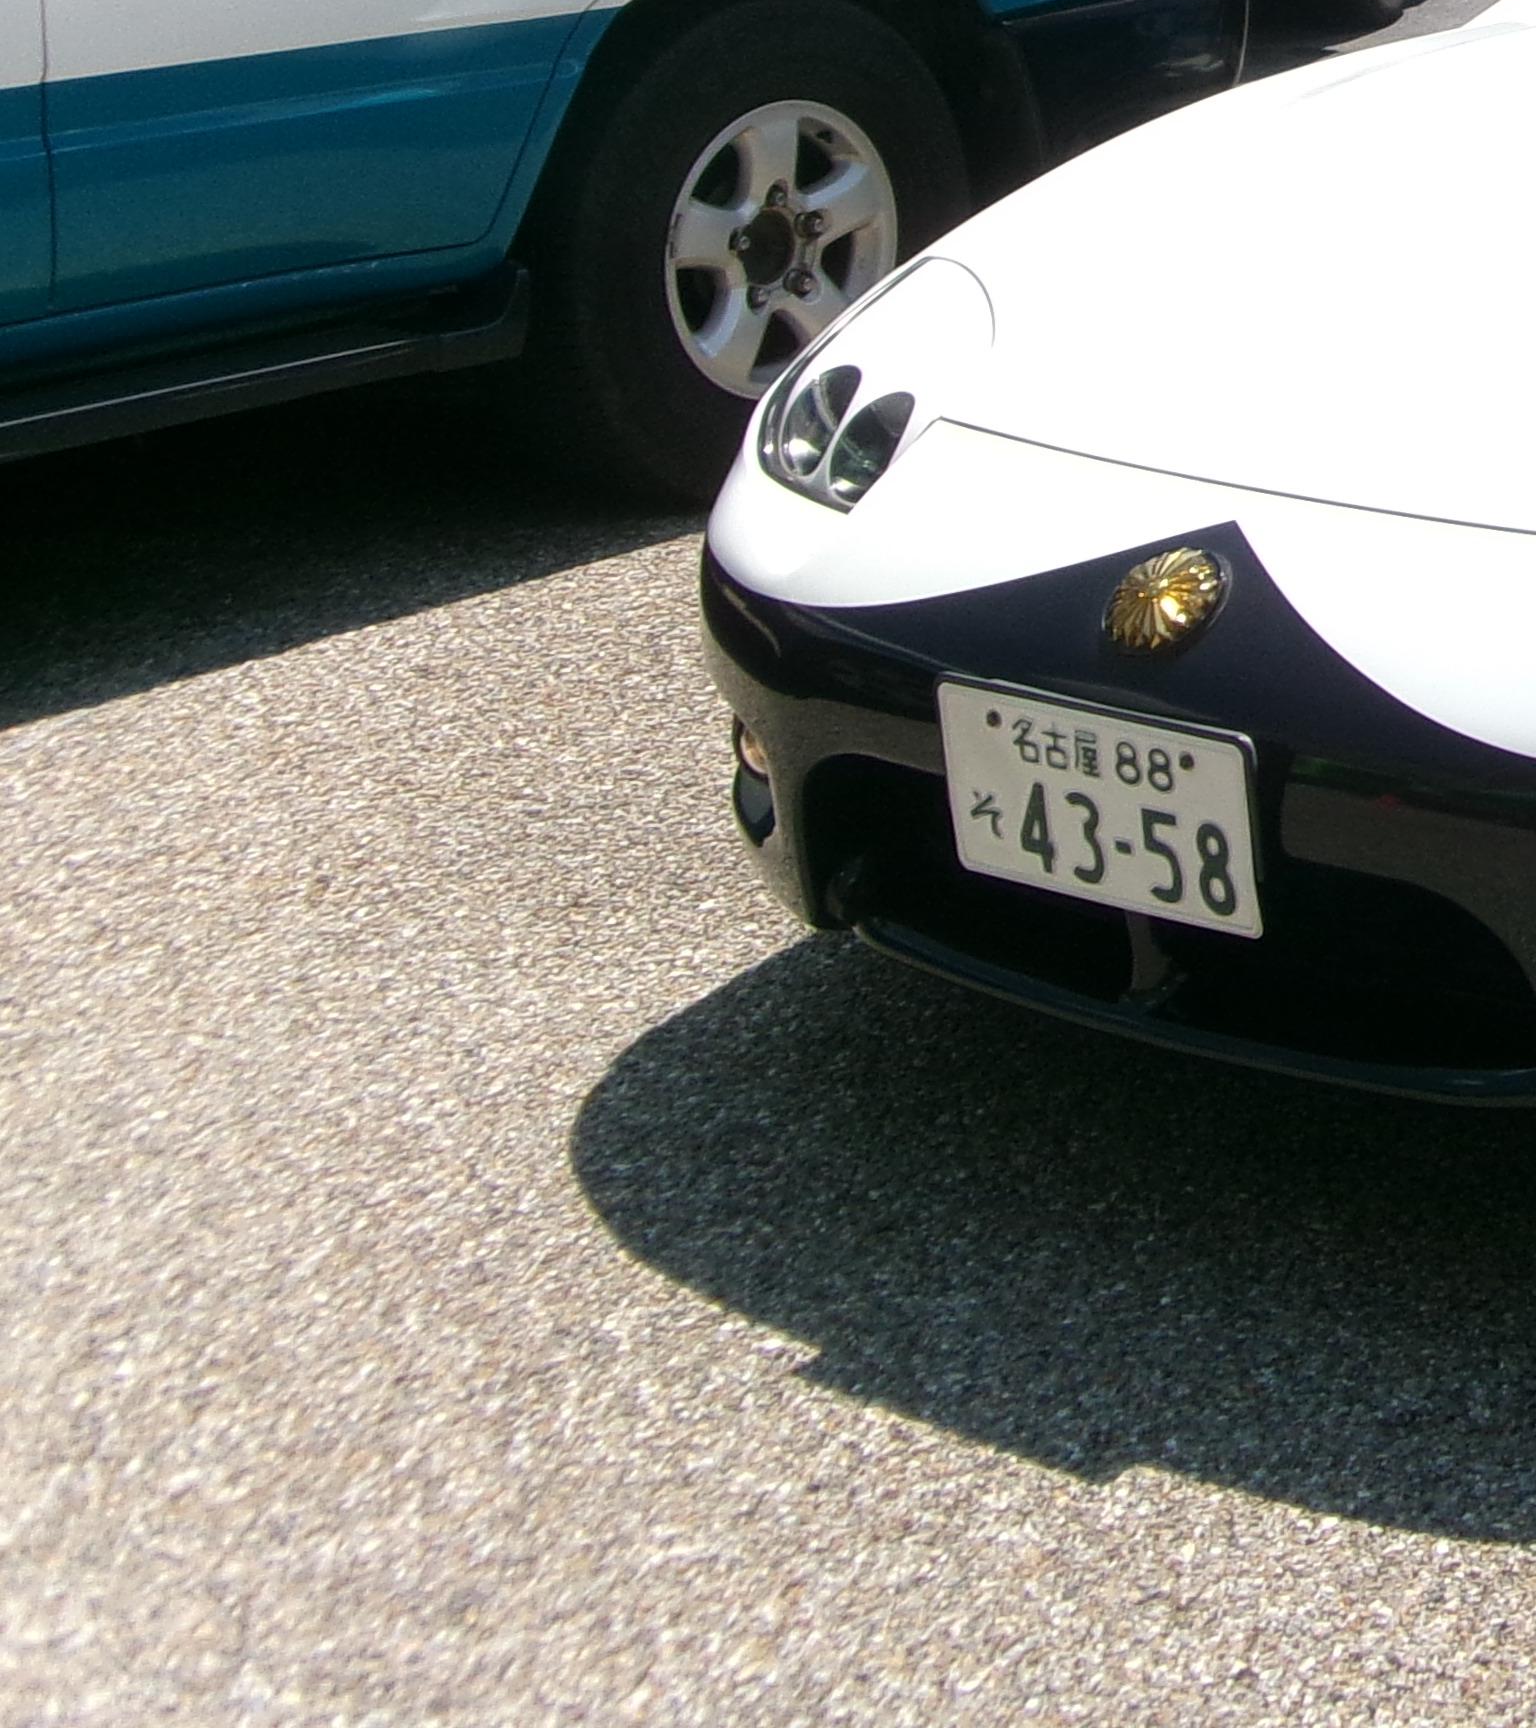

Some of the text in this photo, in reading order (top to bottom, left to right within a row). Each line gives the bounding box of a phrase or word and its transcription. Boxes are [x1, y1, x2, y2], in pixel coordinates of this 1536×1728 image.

[1012, 717, 1175, 793] 名古屋 88
[970, 782, 1237, 916] そ 43-58
